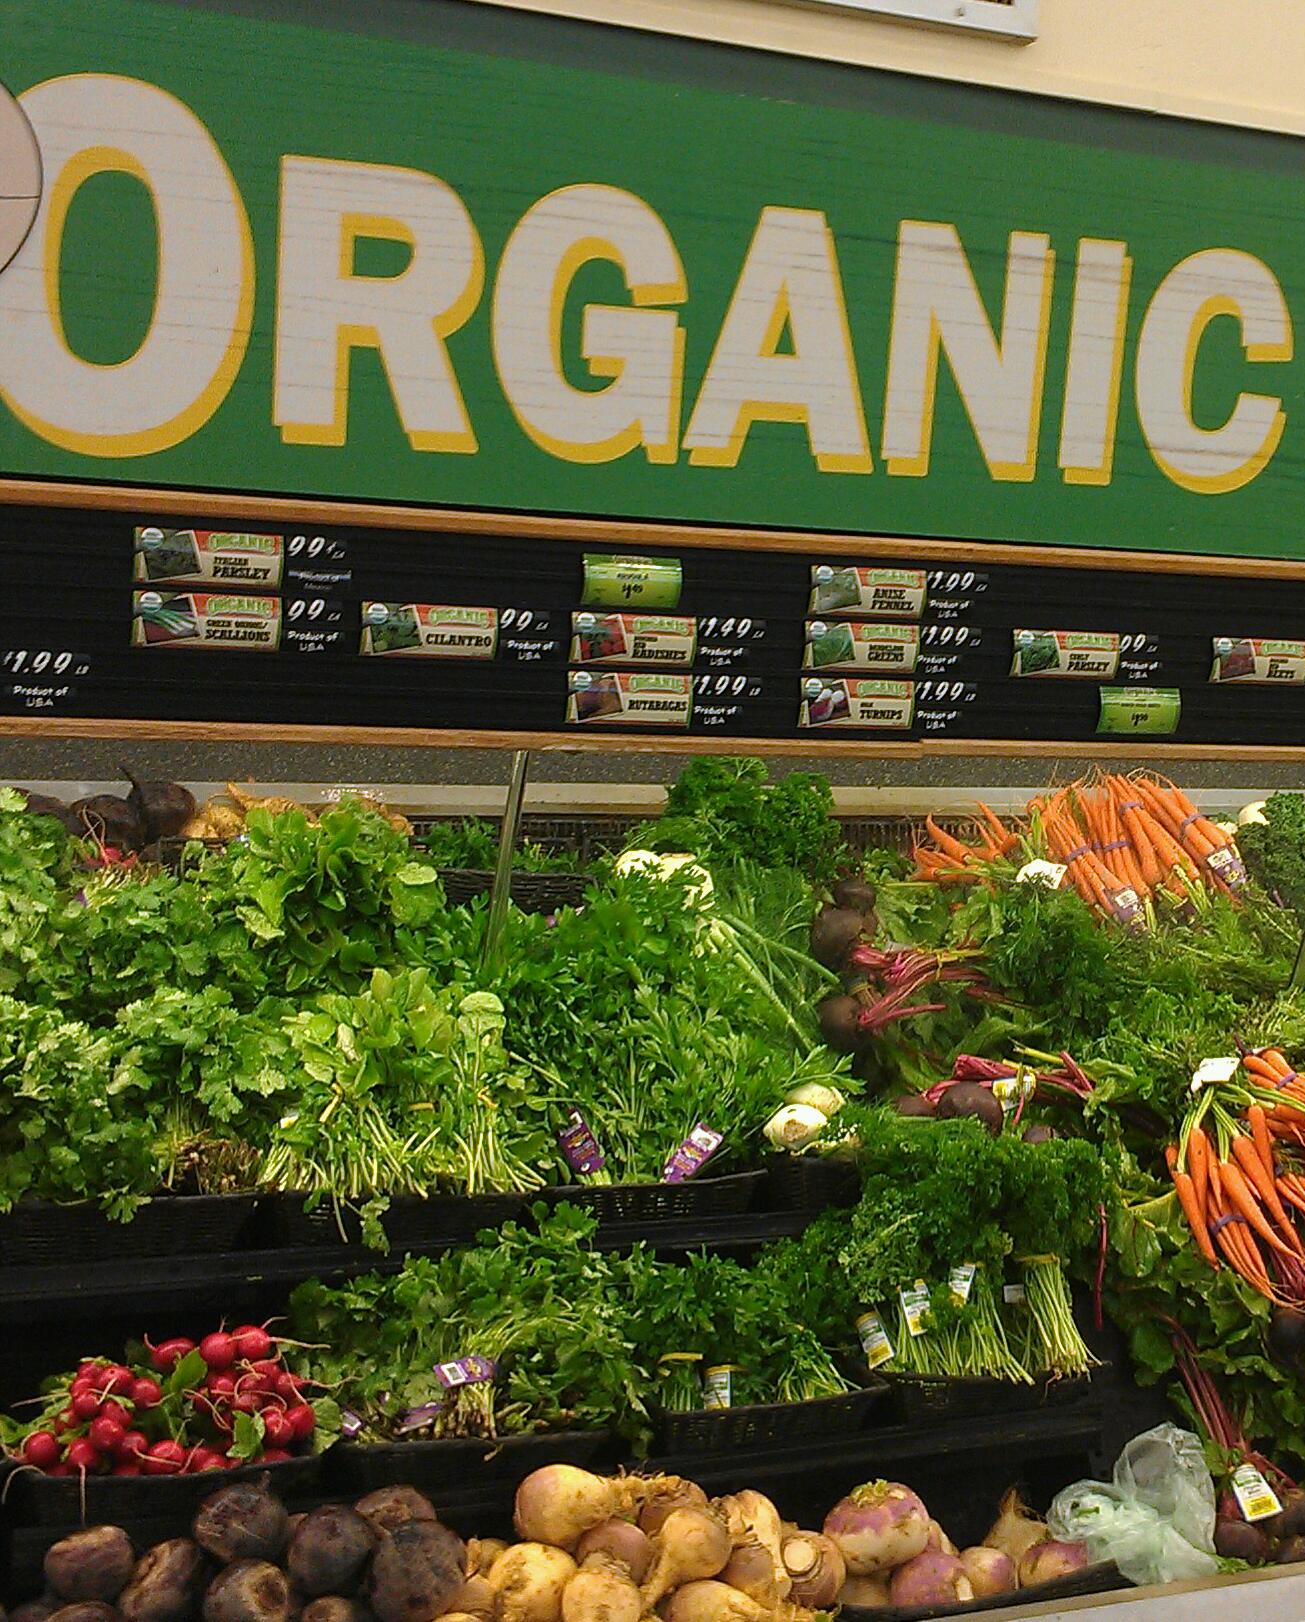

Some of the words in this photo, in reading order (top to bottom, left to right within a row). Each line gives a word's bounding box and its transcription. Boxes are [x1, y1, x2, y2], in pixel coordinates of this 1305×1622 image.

[0, 73, 1294, 495] ORGANIC
[213, 566, 271, 580] PARSLEY
[872, 589, 906, 600] ANISE
[870, 600, 915, 610] FENNEL
[205, 630, 271, 642] SCALLIONS
[288, 630, 324, 641] Product
[326, 631, 339, 641] of
[426, 633, 492, 647] CILANTRO
[300, 642, 324, 651] USA
[507, 639, 541, 650] Product
[542, 641, 554, 650] of
[518, 651, 541, 660] USA
[632, 649, 688, 660] RADISHES
[867, 652, 905, 663] GREENS
[710, 657, 732, 666] USA
[1067, 661, 1111, 671] PARSLEY
[13, 685, 53, 696] Product
[55, 686, 69, 697] of
[26, 697, 54, 708] USA
[628, 699, 688, 711] RUTABAGAS
[859, 709, 903, 720] TURNIPS
[703, 716, 725, 725] USA
[926, 720, 946, 729] USA
